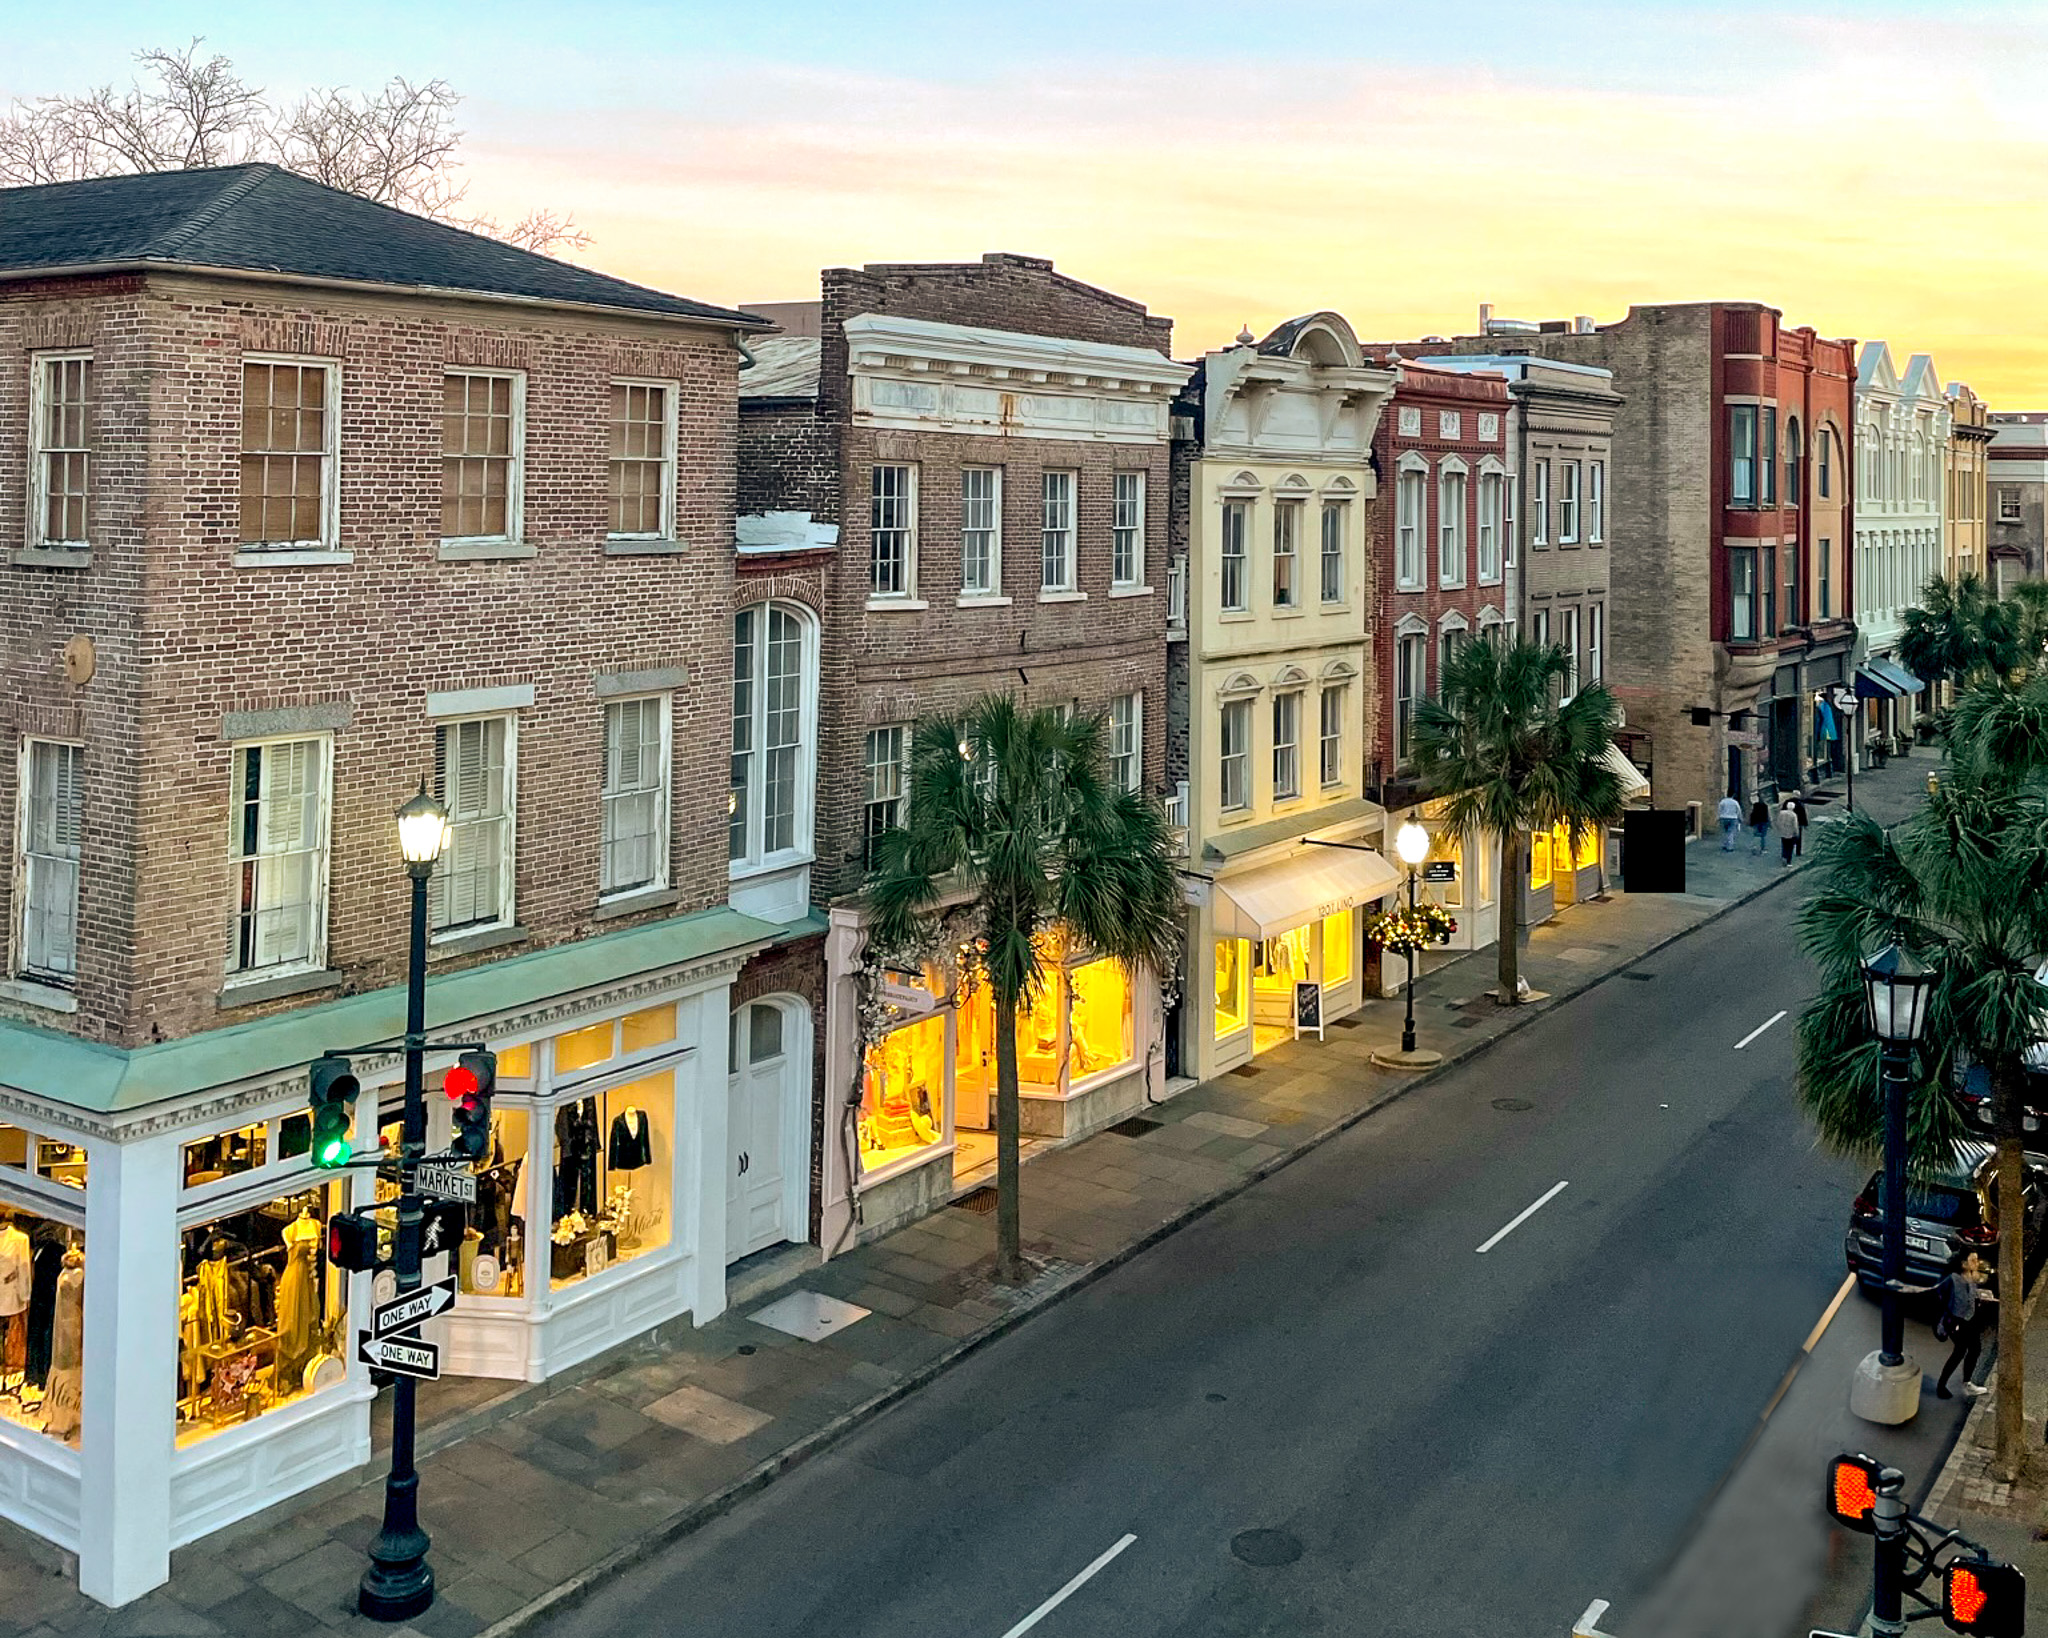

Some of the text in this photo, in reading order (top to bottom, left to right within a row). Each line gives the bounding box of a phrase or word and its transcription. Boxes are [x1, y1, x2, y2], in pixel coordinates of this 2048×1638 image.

[420, 1168, 473, 1197] MARKET ST
[382, 1296, 432, 1327] ONE WAY
[381, 1345, 430, 1366] ONE WAY
